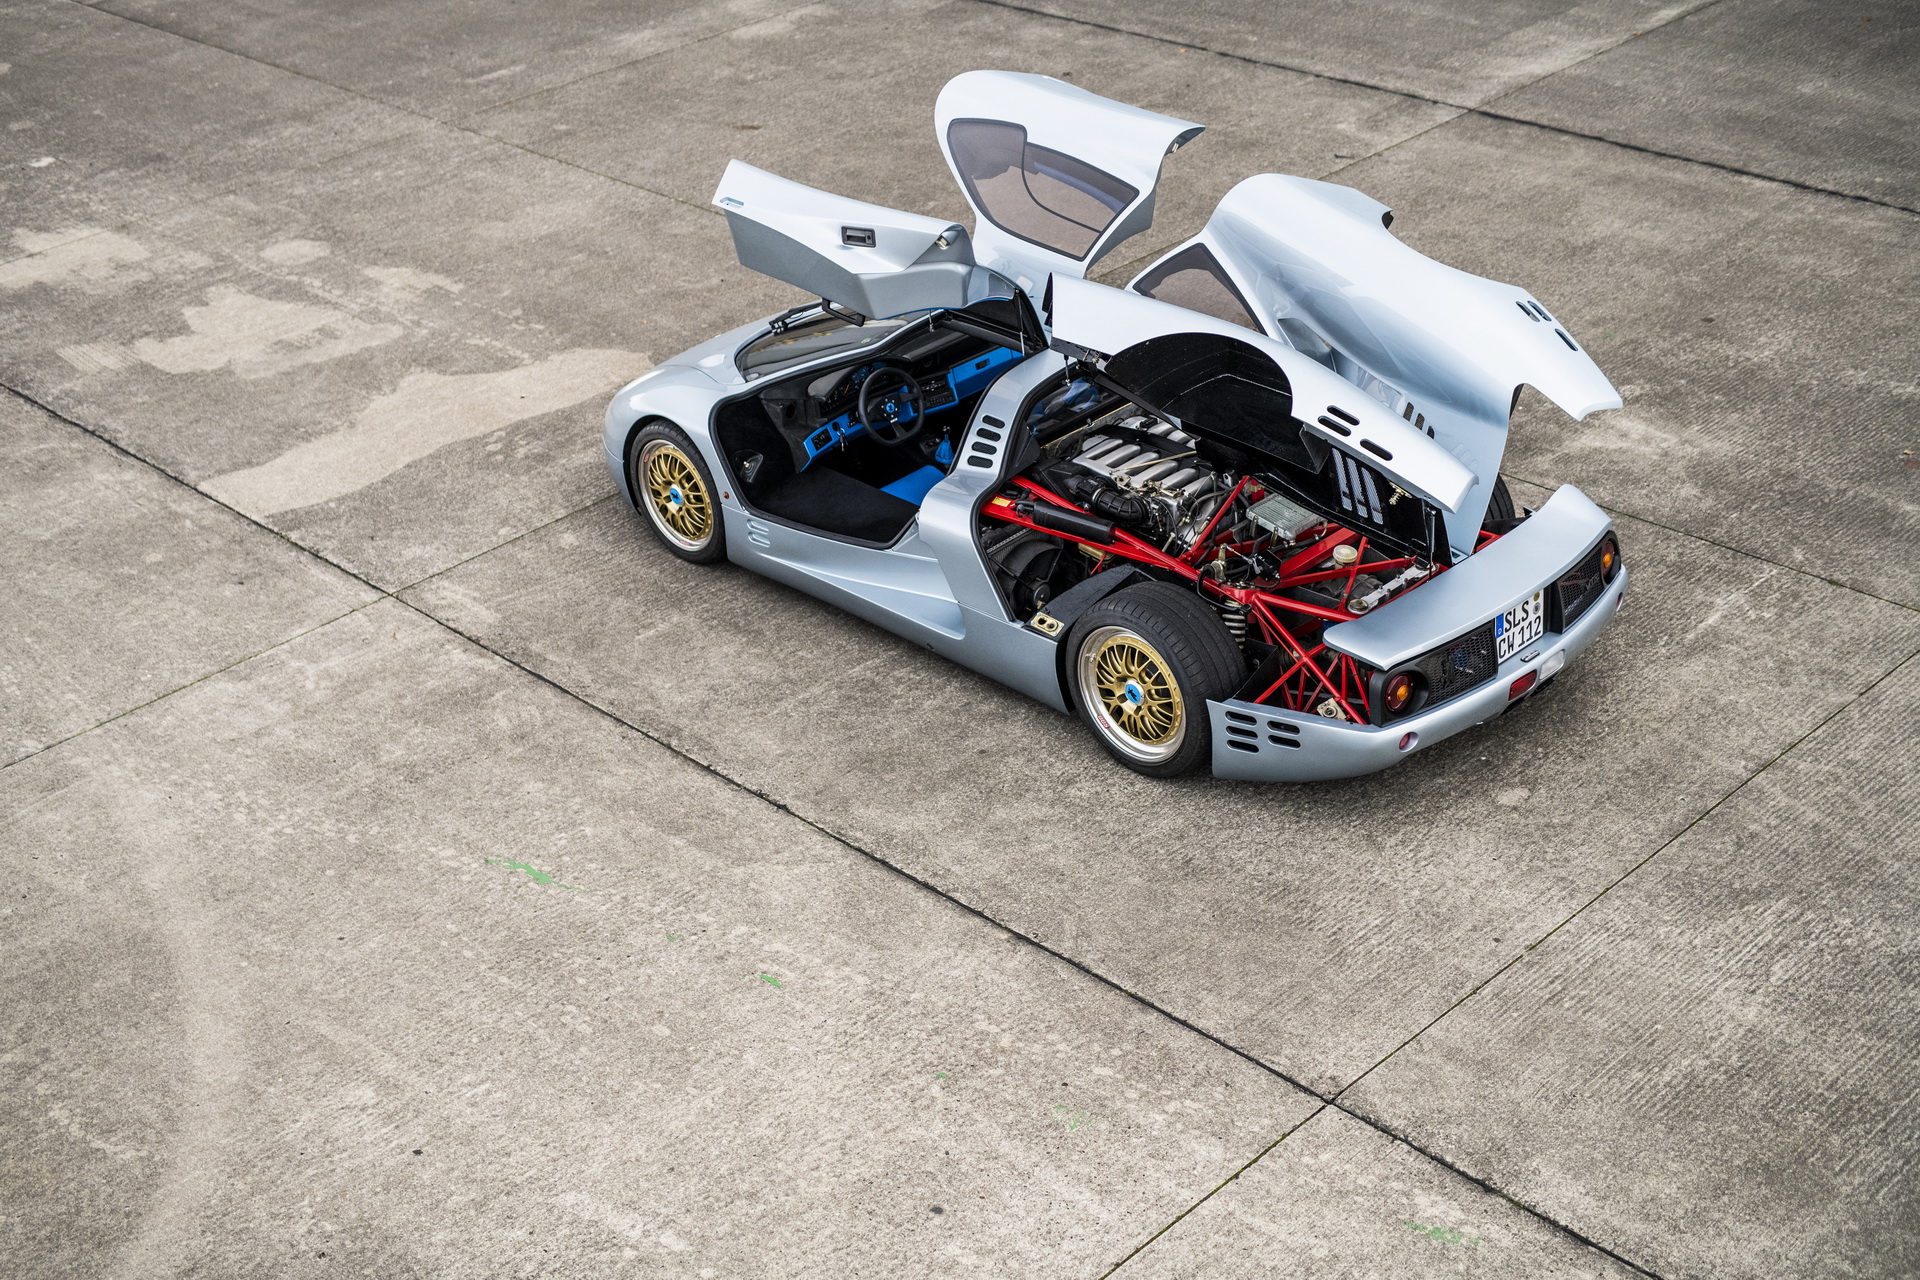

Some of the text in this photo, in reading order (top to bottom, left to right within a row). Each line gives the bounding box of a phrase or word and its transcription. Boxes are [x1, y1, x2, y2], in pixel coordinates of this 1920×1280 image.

[1505, 600, 1529, 633] SLS
[1498, 615, 1541, 659] CW 112
